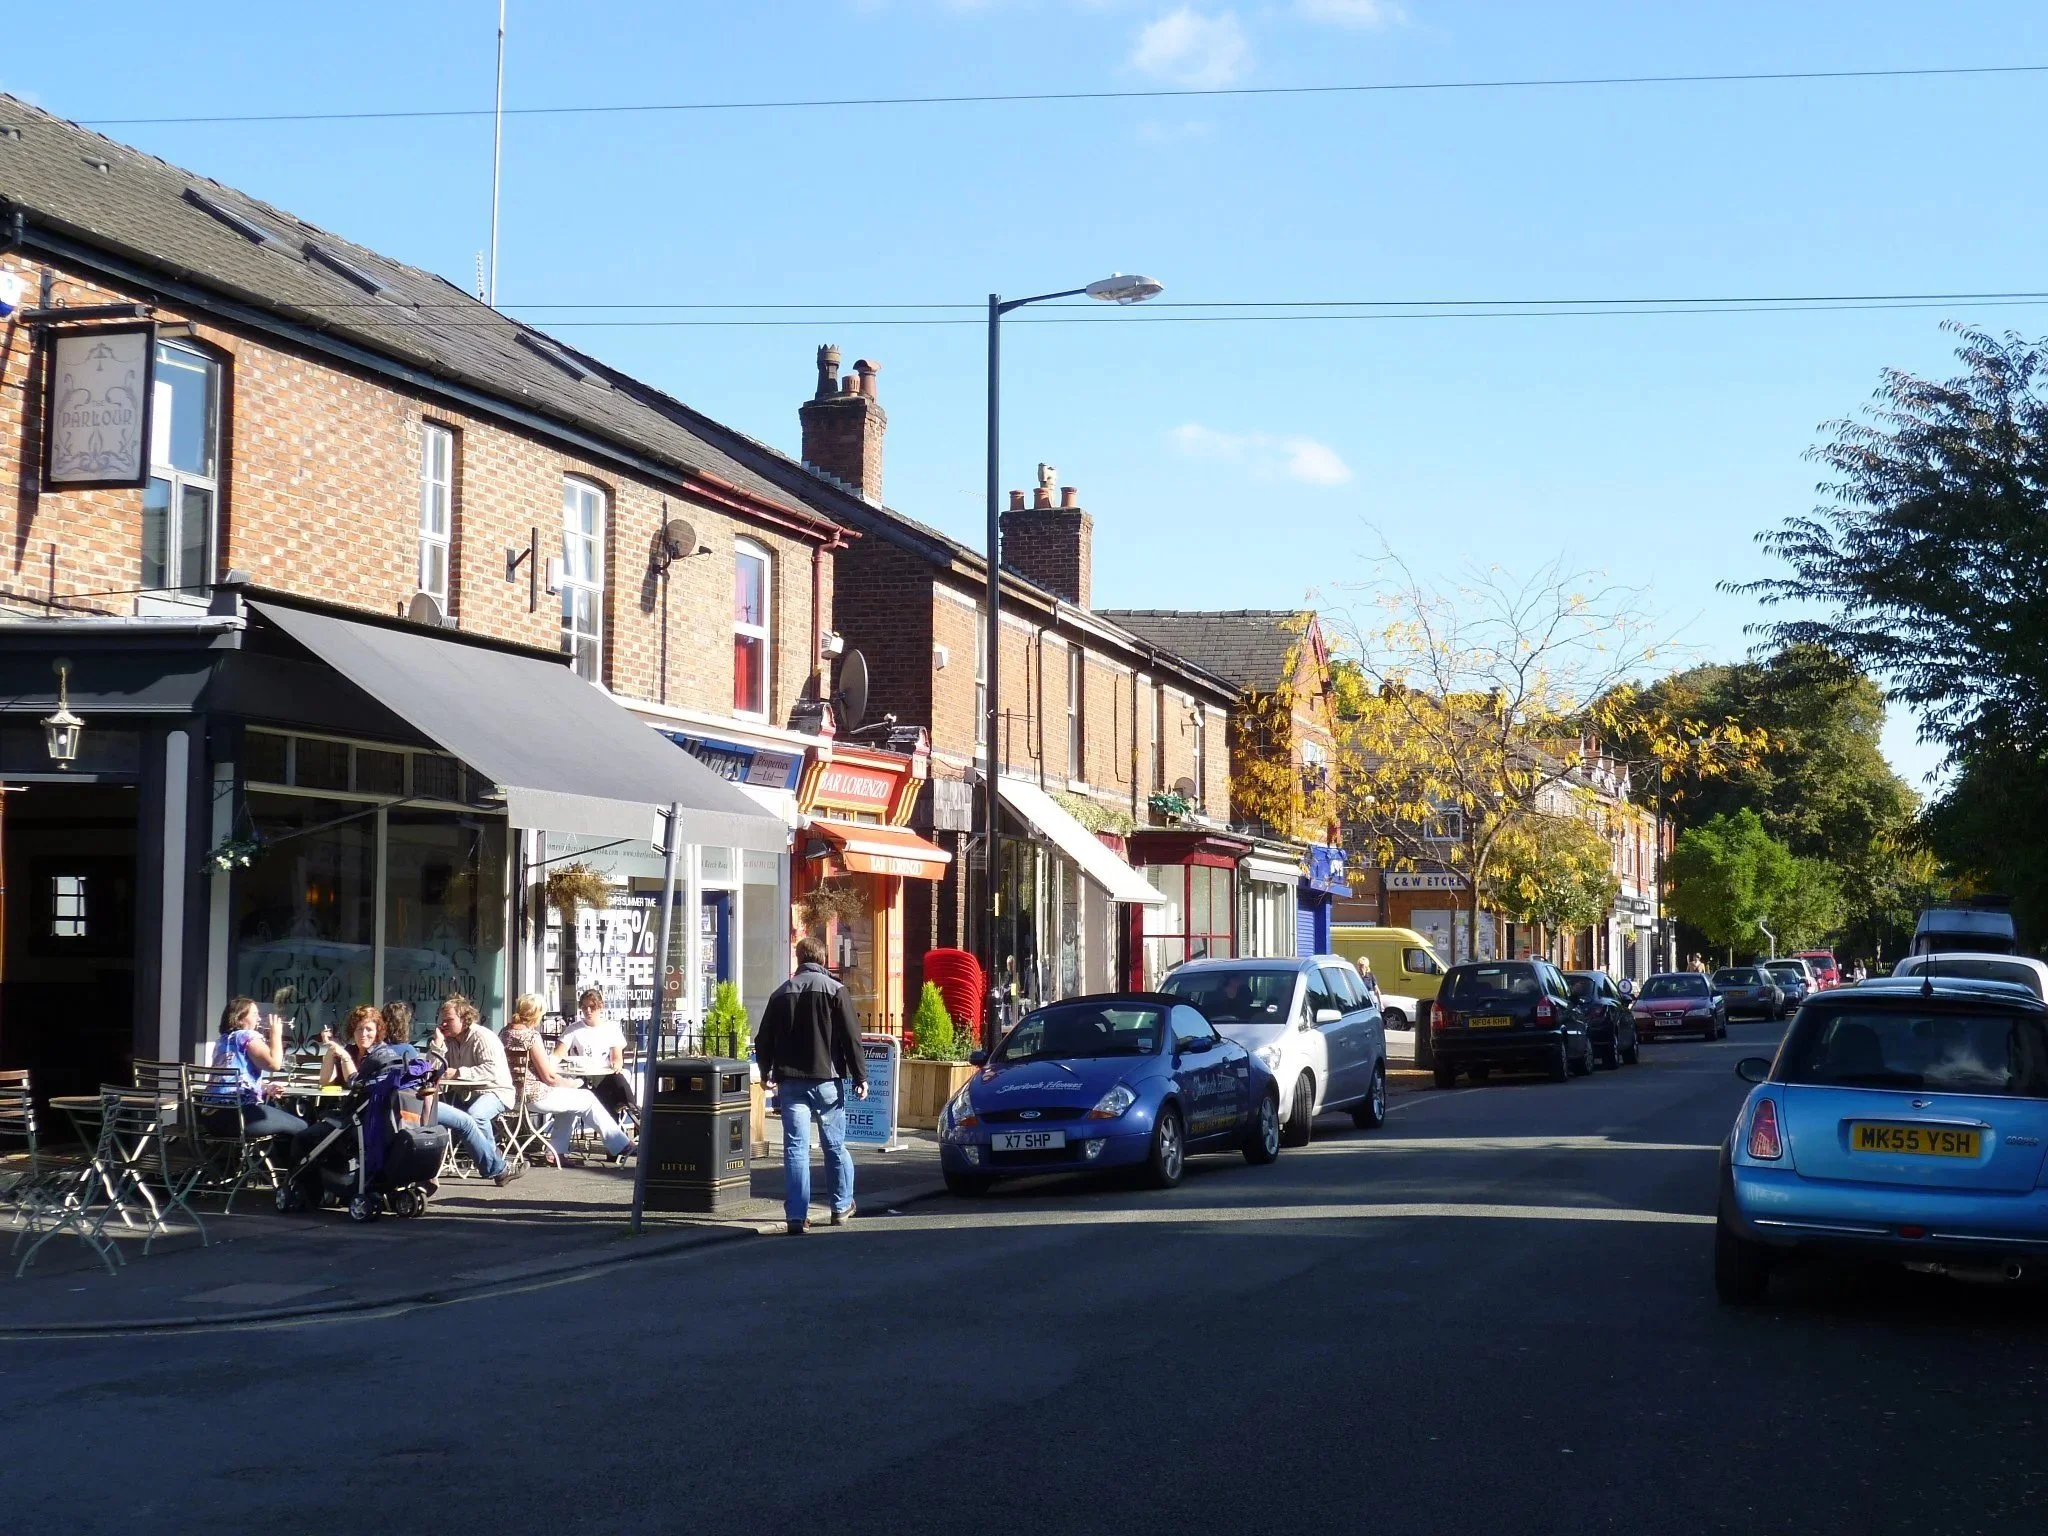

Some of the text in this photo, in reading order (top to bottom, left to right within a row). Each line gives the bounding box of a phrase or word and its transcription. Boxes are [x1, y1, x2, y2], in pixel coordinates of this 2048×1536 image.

[62, 409, 133, 428] PARLOUR
[757, 755, 789, 771] Properties
[762, 770, 775, 782] Ltd
[820, 771, 890, 799] BAR LORENZO
[1427, 877, 1462, 887] ETCHE
[622, 897, 644, 907] SUMMER
[645, 897, 657, 907] TIME
[578, 907, 655, 955] 0.75%
[578, 956, 654, 986] SALE FEE
[853, 1129, 886, 1137] APPRAISAL
[1005, 1134, 1051, 1148] X7 SHP
[1861, 1127, 1971, 1154] MK55 YSH
[661, 1163, 696, 1171] LITTER
[726, 1160, 744, 1170] LITTER
